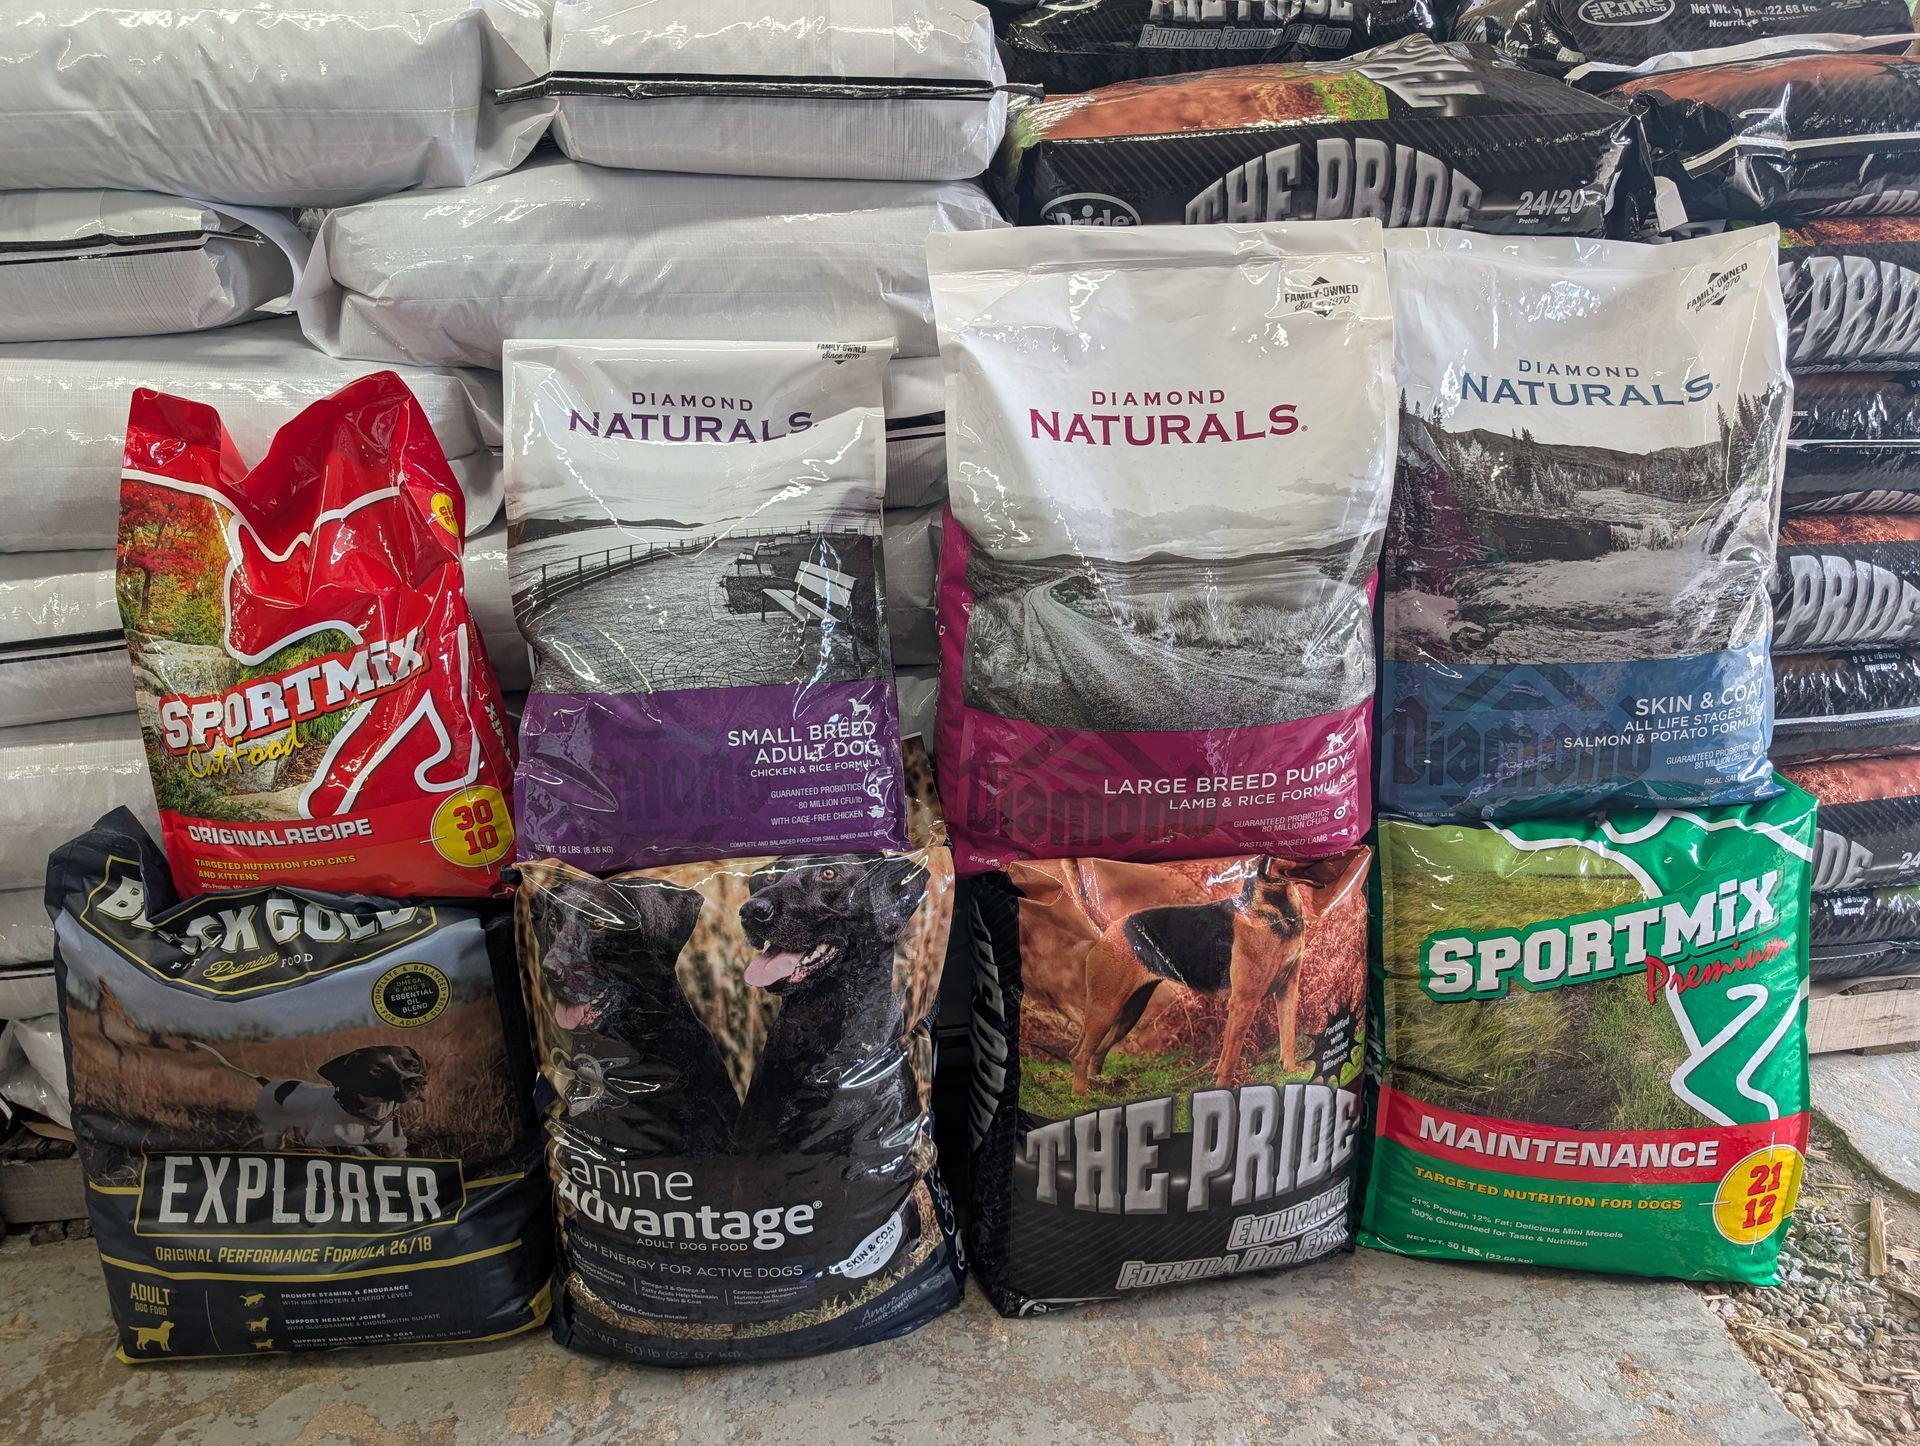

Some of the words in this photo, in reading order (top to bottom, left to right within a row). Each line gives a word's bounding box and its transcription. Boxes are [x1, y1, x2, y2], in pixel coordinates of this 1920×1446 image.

[1637, 6, 1667, 14] FOOD
[1140, 25, 1221, 48] ENDURANCE
[1219, 27, 1283, 48] FORMULA
[1310, 25, 1351, 48] FOOD
[1185, 142, 1301, 225] THE
[1316, 137, 1483, 233] PRIDE
[1516, 189, 1584, 216] 24/20
[1284, 284, 1359, 303] FAMILY-OWNED
[1687, 262, 1748, 310] FAMILY-OWNED
[1695, 292, 1720, 314] Since
[1723, 274, 1741, 293] 1970
[816, 343, 867, 354] FAMILY-OWNED
[822, 351, 843, 360] Since
[1519, 359, 1640, 379] DIAMOND
[632, 392, 753, 411] DIAMOND
[1091, 389, 1226, 407] DIAMOND
[1461, 372, 1713, 407] NATURALS
[569, 409, 814, 444] NATURALS
[1029, 403, 1300, 447] NATURALS
[1635, 695, 1692, 716] SKIN
[1700, 691, 1714, 709] &
[1721, 677, 1763, 704] COAT
[1563, 735, 1631, 749] SALMON
[1635, 734, 1646, 745] &
[1650, 727, 1708, 743] POTATO
[1712, 716, 1762, 735] FORMULA
[1624, 720, 1652, 733] ALL
[1658, 717, 1689, 729] LIFE
[1693, 706, 1742, 725] STAGES
[728, 727, 802, 746] SMALL
[810, 721, 876, 741] BREED
[187, 746, 231, 778] Cat
[231, 720, 305, 774] Food
[755, 744, 825, 764] ADULT
[835, 739, 879, 757] DOG
[1666, 750, 1714, 765] GUARANTEED
[1715, 742, 1750, 758] PROBIOTICS
[751, 767, 797, 777] CHICKEN
[809, 764, 832, 773] RICE
[835, 759, 880, 770] FORMULA
[1104, 779, 1186, 795] LARGE
[1196, 772, 1277, 792] BREED
[1286, 755, 1348, 785] PUPPY
[1704, 777, 1722, 786] REAL
[771, 788, 818, 798] GUARANTEED
[820, 783, 861, 793] PROBIOTICS
[809, 798, 839, 808] MILLION
[1169, 798, 1216, 810] LAMB
[1222, 797, 1232, 808] &
[1238, 793, 1275, 805] RICE
[1281, 774, 1348, 801] FORMULA
[453, 799, 493, 832] 30
[771, 817, 789, 826] WITH
[791, 813, 831, 824] CAGE-FREE
[833, 810, 863, 820] CHICKEN
[1233, 817, 1285, 828] GUARANTEED
[1287, 808, 1330, 822] PROBIOTICS
[1274, 822, 1305, 832] MILLION
[188, 825, 285, 847] ORIGINAL
[288, 818, 374, 844] RECIPE
[464, 824, 499, 856] 10
[1239, 839, 1305, 848] PASTURE-RAISED
[1307, 834, 1328, 844] LAMB
[195, 858, 241, 871] TARGETED
[243, 859, 300, 871] NUTRITION
[303, 857, 325, 868] FOR
[326, 855, 357, 866] CATS
[546, 845, 556, 853] WT.
[568, 846, 582, 854] LBS.
[602, 846, 613, 854] KG)
[198, 870, 216, 879] AND
[218, 871, 260, 881] KITTENS
[96, 876, 261, 955] BCK
[202, 952, 279, 982] Premium
[281, 953, 314, 968] FOOD
[1645, 940, 1788, 1005] Premium
[391, 988, 434, 1001] ESSENTIAL
[402, 1003, 428, 1013] BLEND
[407, 998, 420, 1006] OIL
[1026, 1097, 1174, 1215] THE
[1187, 1084, 1359, 1212] PRIDE
[1420, 1115, 1719, 1167] MAINTENANCE
[158, 1156, 442, 1224] EXPLORER
[1415, 1167, 1498, 1196] TARGETED
[1504, 1188, 1596, 1208] NUTRITION
[1601, 1198, 1633, 1209] FOR
[1637, 1199, 1683, 1210] DOGS
[1747, 1161, 1782, 1196] 21
[558, 1172, 814, 1250] Advantage
[1228, 1178, 1349, 1249] ENDURANCE
[1411, 1197, 1431, 1208] 21%
[1433, 1203, 1469, 1219] Protein,
[1472, 1214, 1492, 1223] 12%
[1515, 1222, 1560, 1234] Delicious
[1562, 1227, 1583, 1236] Mini
[1585, 1229, 1623, 1239] Morsels
[1742, 1194, 1777, 1229] 12
[1410, 1208, 1434, 1221] 100%
[1436, 1216, 1490, 1235] Guaranteed
[1493, 1228, 1505, 1237] for
[1509, 1232, 1534, 1242] Taste
[1536, 1235, 1544, 1243] &
[1547, 1236, 1588, 1247] Nutrition
[155, 1246, 213, 1263] ORIGINAL
[218, 1247, 319, 1263] PERFORMANCE
[323, 1244, 386, 1262] FORMULA
[390, 1236, 432, 1256] 26/18
[637, 1238, 675, 1250] ADULT
[680, 1242, 707, 1251] DOG
[712, 1243, 748, 1251] FOOD
[846, 1251, 868, 1271] SKIN
[875, 1221, 897, 1244] COAT
[1447, 1241, 1459, 1250] 50
[1461, 1246, 1483, 1257] LBS.
[601, 1247, 656, 1271] ENERGY
[660, 1263, 692, 1276] FOR
[697, 1266, 752, 1278] ACTIVE
[758, 1265, 803, 1278] DOGS
[1116, 1257, 1238, 1289] FORMULA
[1237, 1241, 1296, 1271] DOG
[130, 1282, 171, 1306] ADULT
[319, 1290, 352, 1298] STAMINA
[363, 1285, 410, 1295] ENDURANCE
[135, 1302, 149, 1313] DOG
[150, 1303, 168, 1316] FOOD
[285, 1317, 319, 1325] SUPPORT
[625, 1343, 643, 1356] 50
